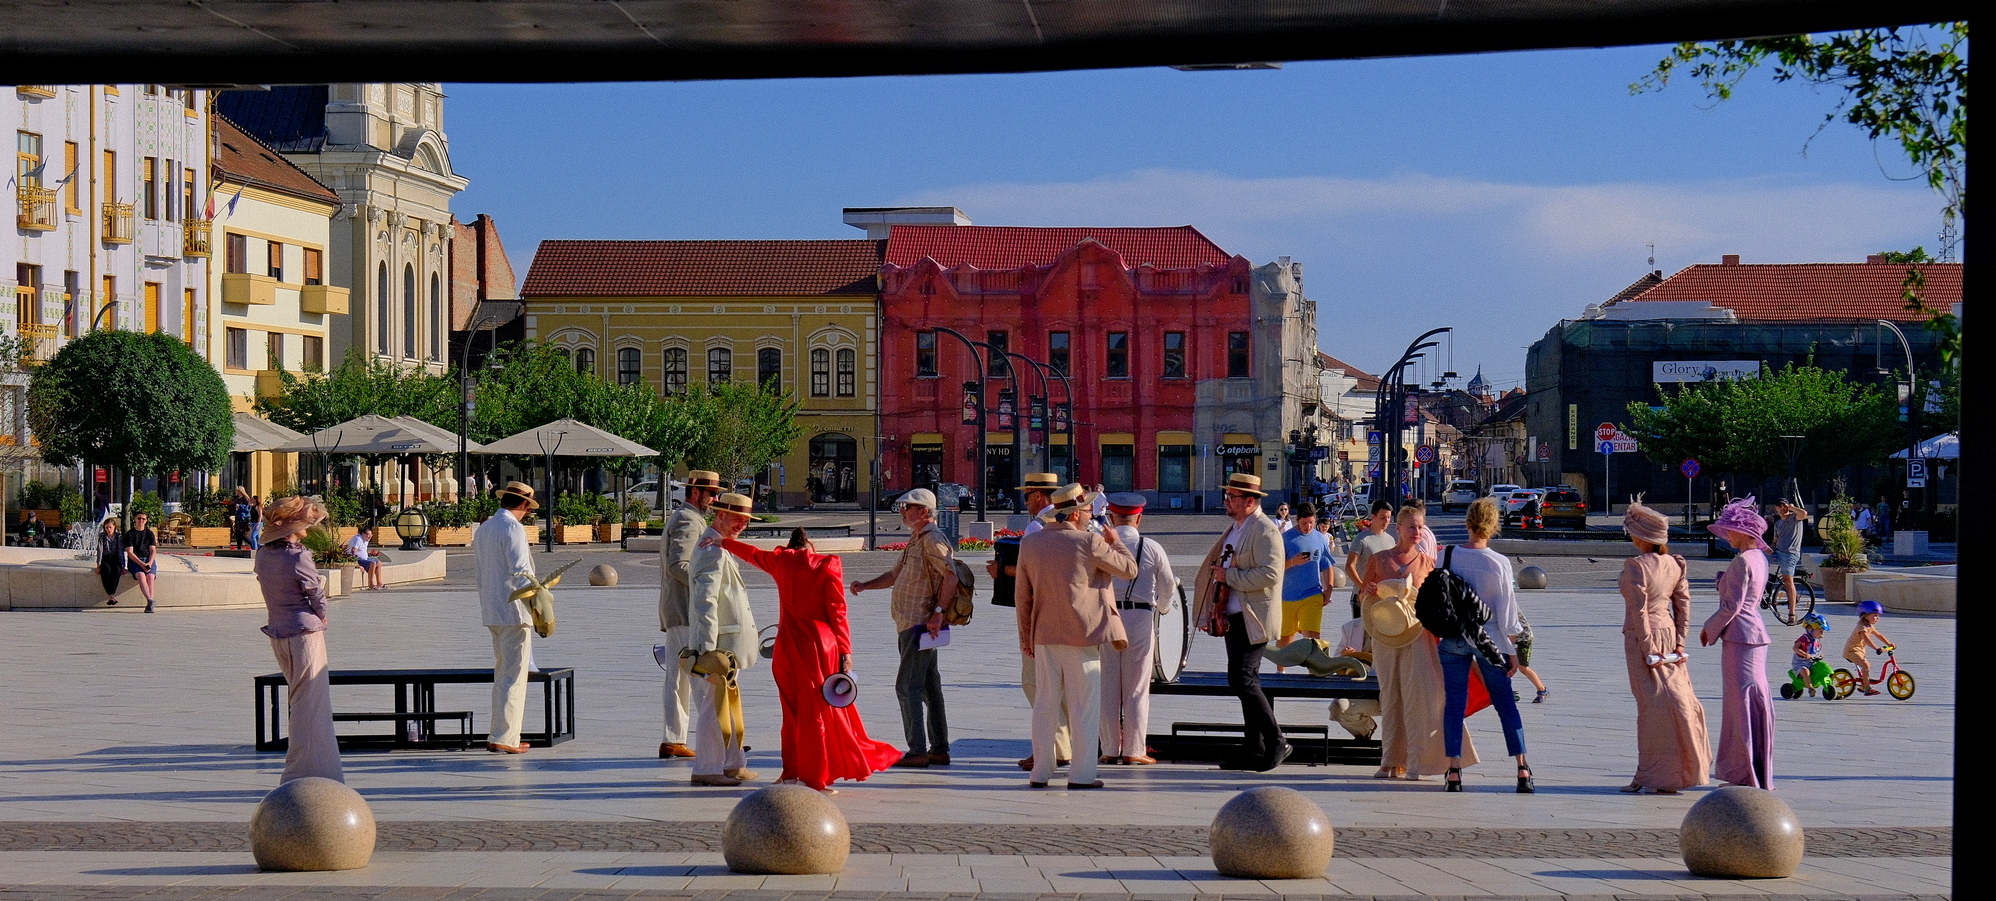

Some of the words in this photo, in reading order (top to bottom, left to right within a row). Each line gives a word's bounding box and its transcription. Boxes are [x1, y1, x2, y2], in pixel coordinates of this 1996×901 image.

[1662, 363, 1699, 377] Glory
[1599, 428, 1615, 436] STOP
[998, 447, 1010, 455] HD
[1227, 445, 1260, 455] otpbank
[1597, 442, 1636, 451] AENTAR
